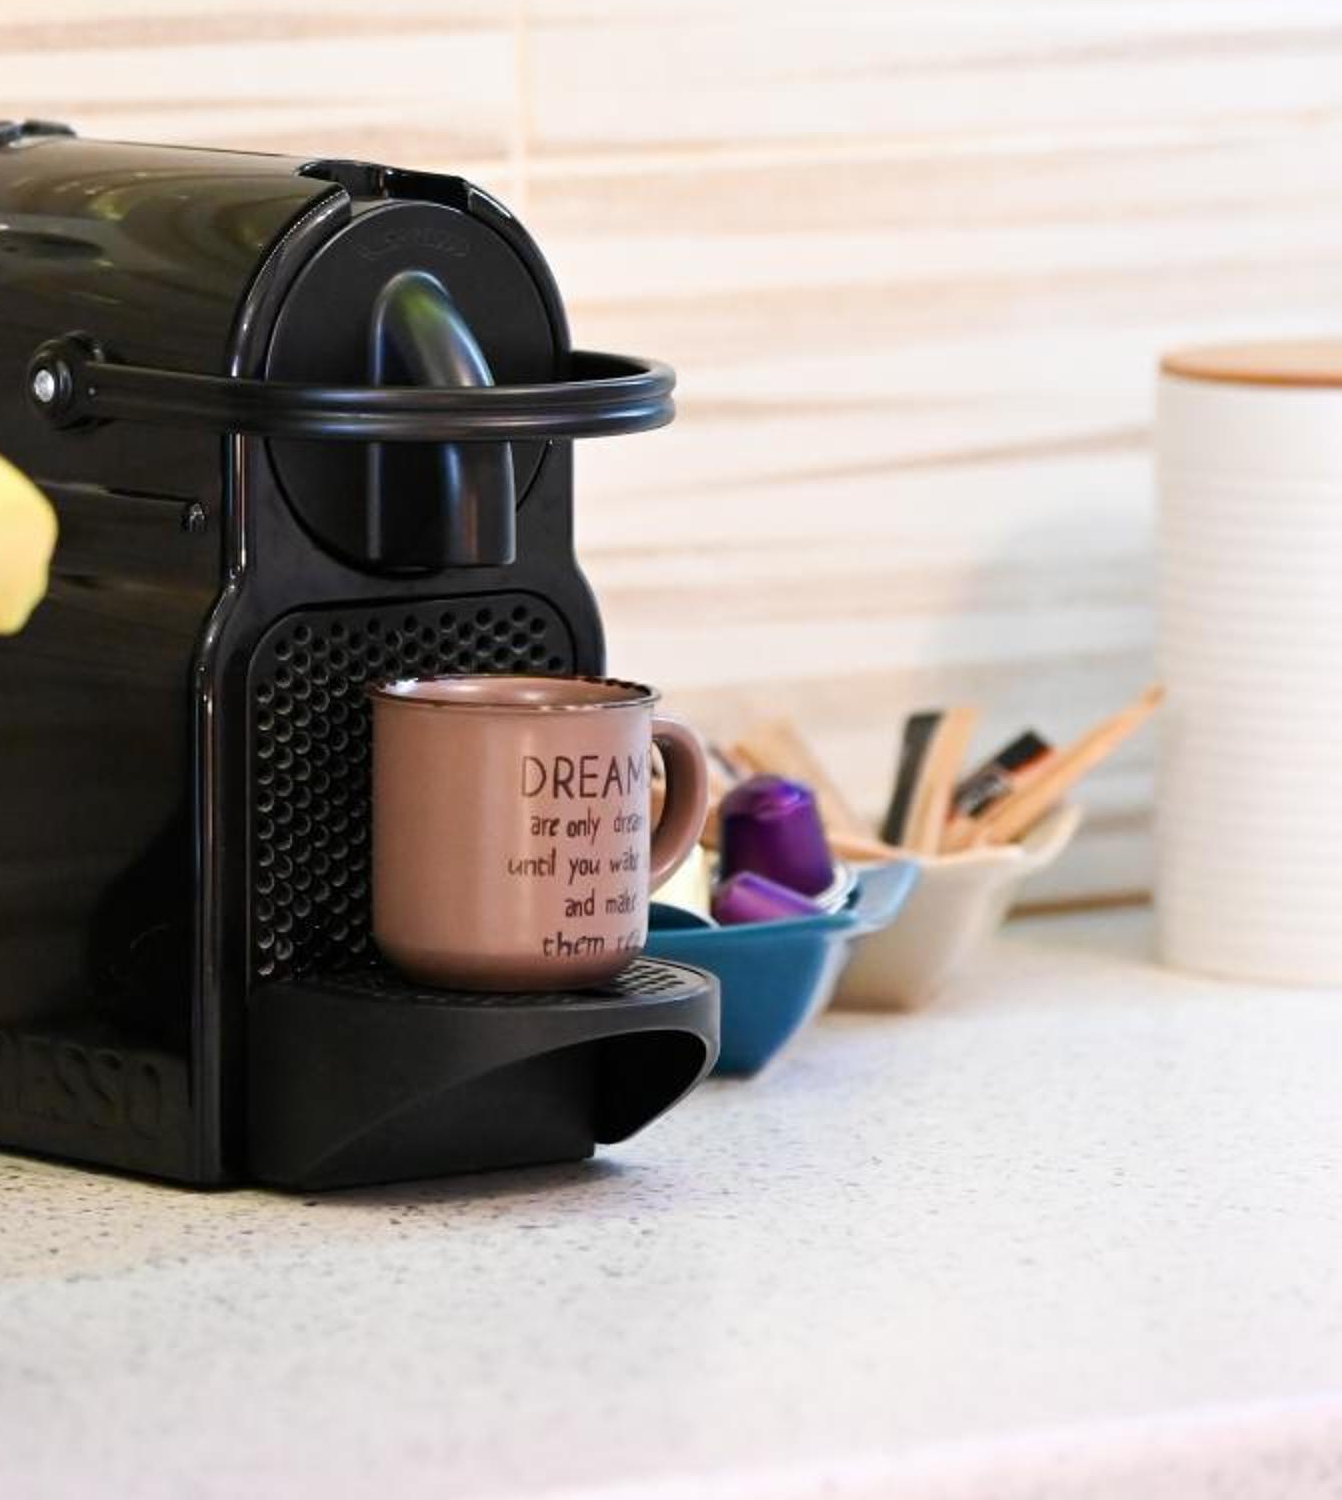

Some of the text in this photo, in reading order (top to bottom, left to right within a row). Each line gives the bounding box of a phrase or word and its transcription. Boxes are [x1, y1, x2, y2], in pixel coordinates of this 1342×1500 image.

[522, 755, 643, 799] DREAM
[530, 815, 560, 837] are
[566, 806, 601, 845] only
[508, 847, 557, 877] until
[569, 857, 601, 885] you
[564, 887, 595, 917] and
[542, 931, 605, 957] them
